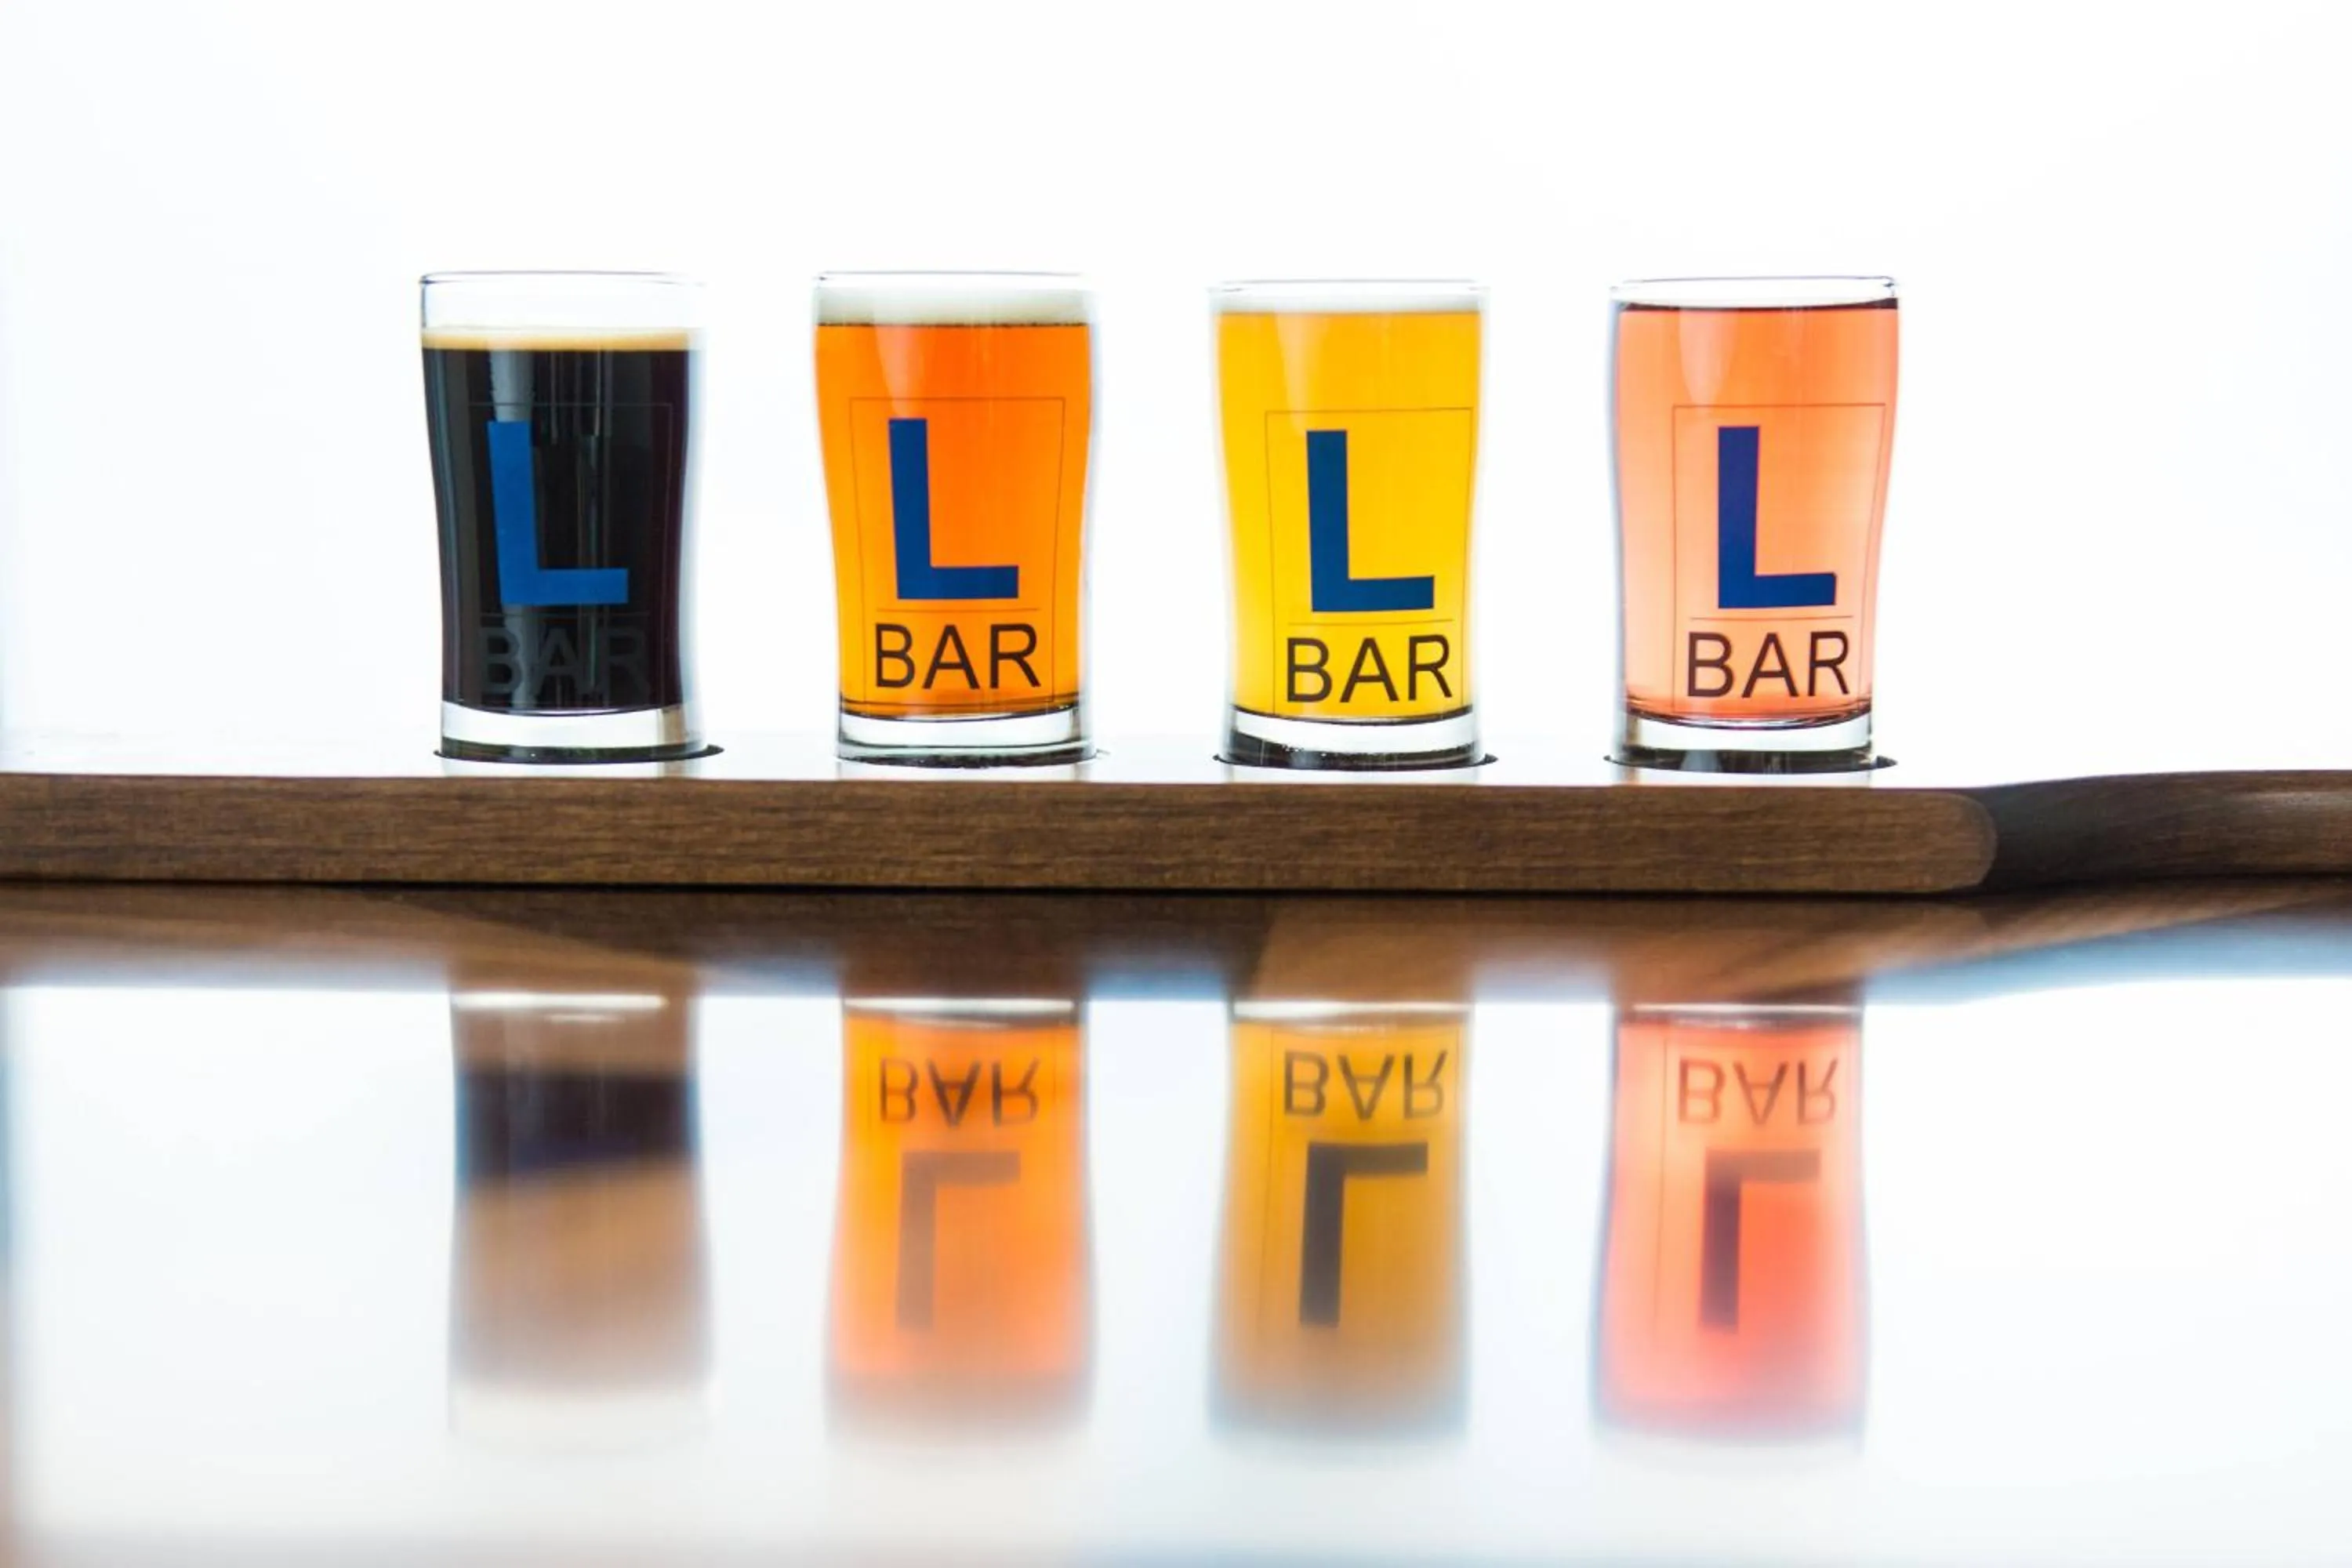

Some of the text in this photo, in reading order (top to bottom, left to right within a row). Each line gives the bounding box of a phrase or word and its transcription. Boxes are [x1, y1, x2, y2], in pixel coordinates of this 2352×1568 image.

[488, 421, 627, 604] L
[887, 419, 1019, 601] L
[1306, 429, 1434, 612] L
[1718, 426, 1837, 609] L
[482, 626, 651, 695] BAR
[876, 622, 1040, 690] BAR
[1286, 633, 1453, 703] BAR
[1687, 630, 1850, 699] BAR
